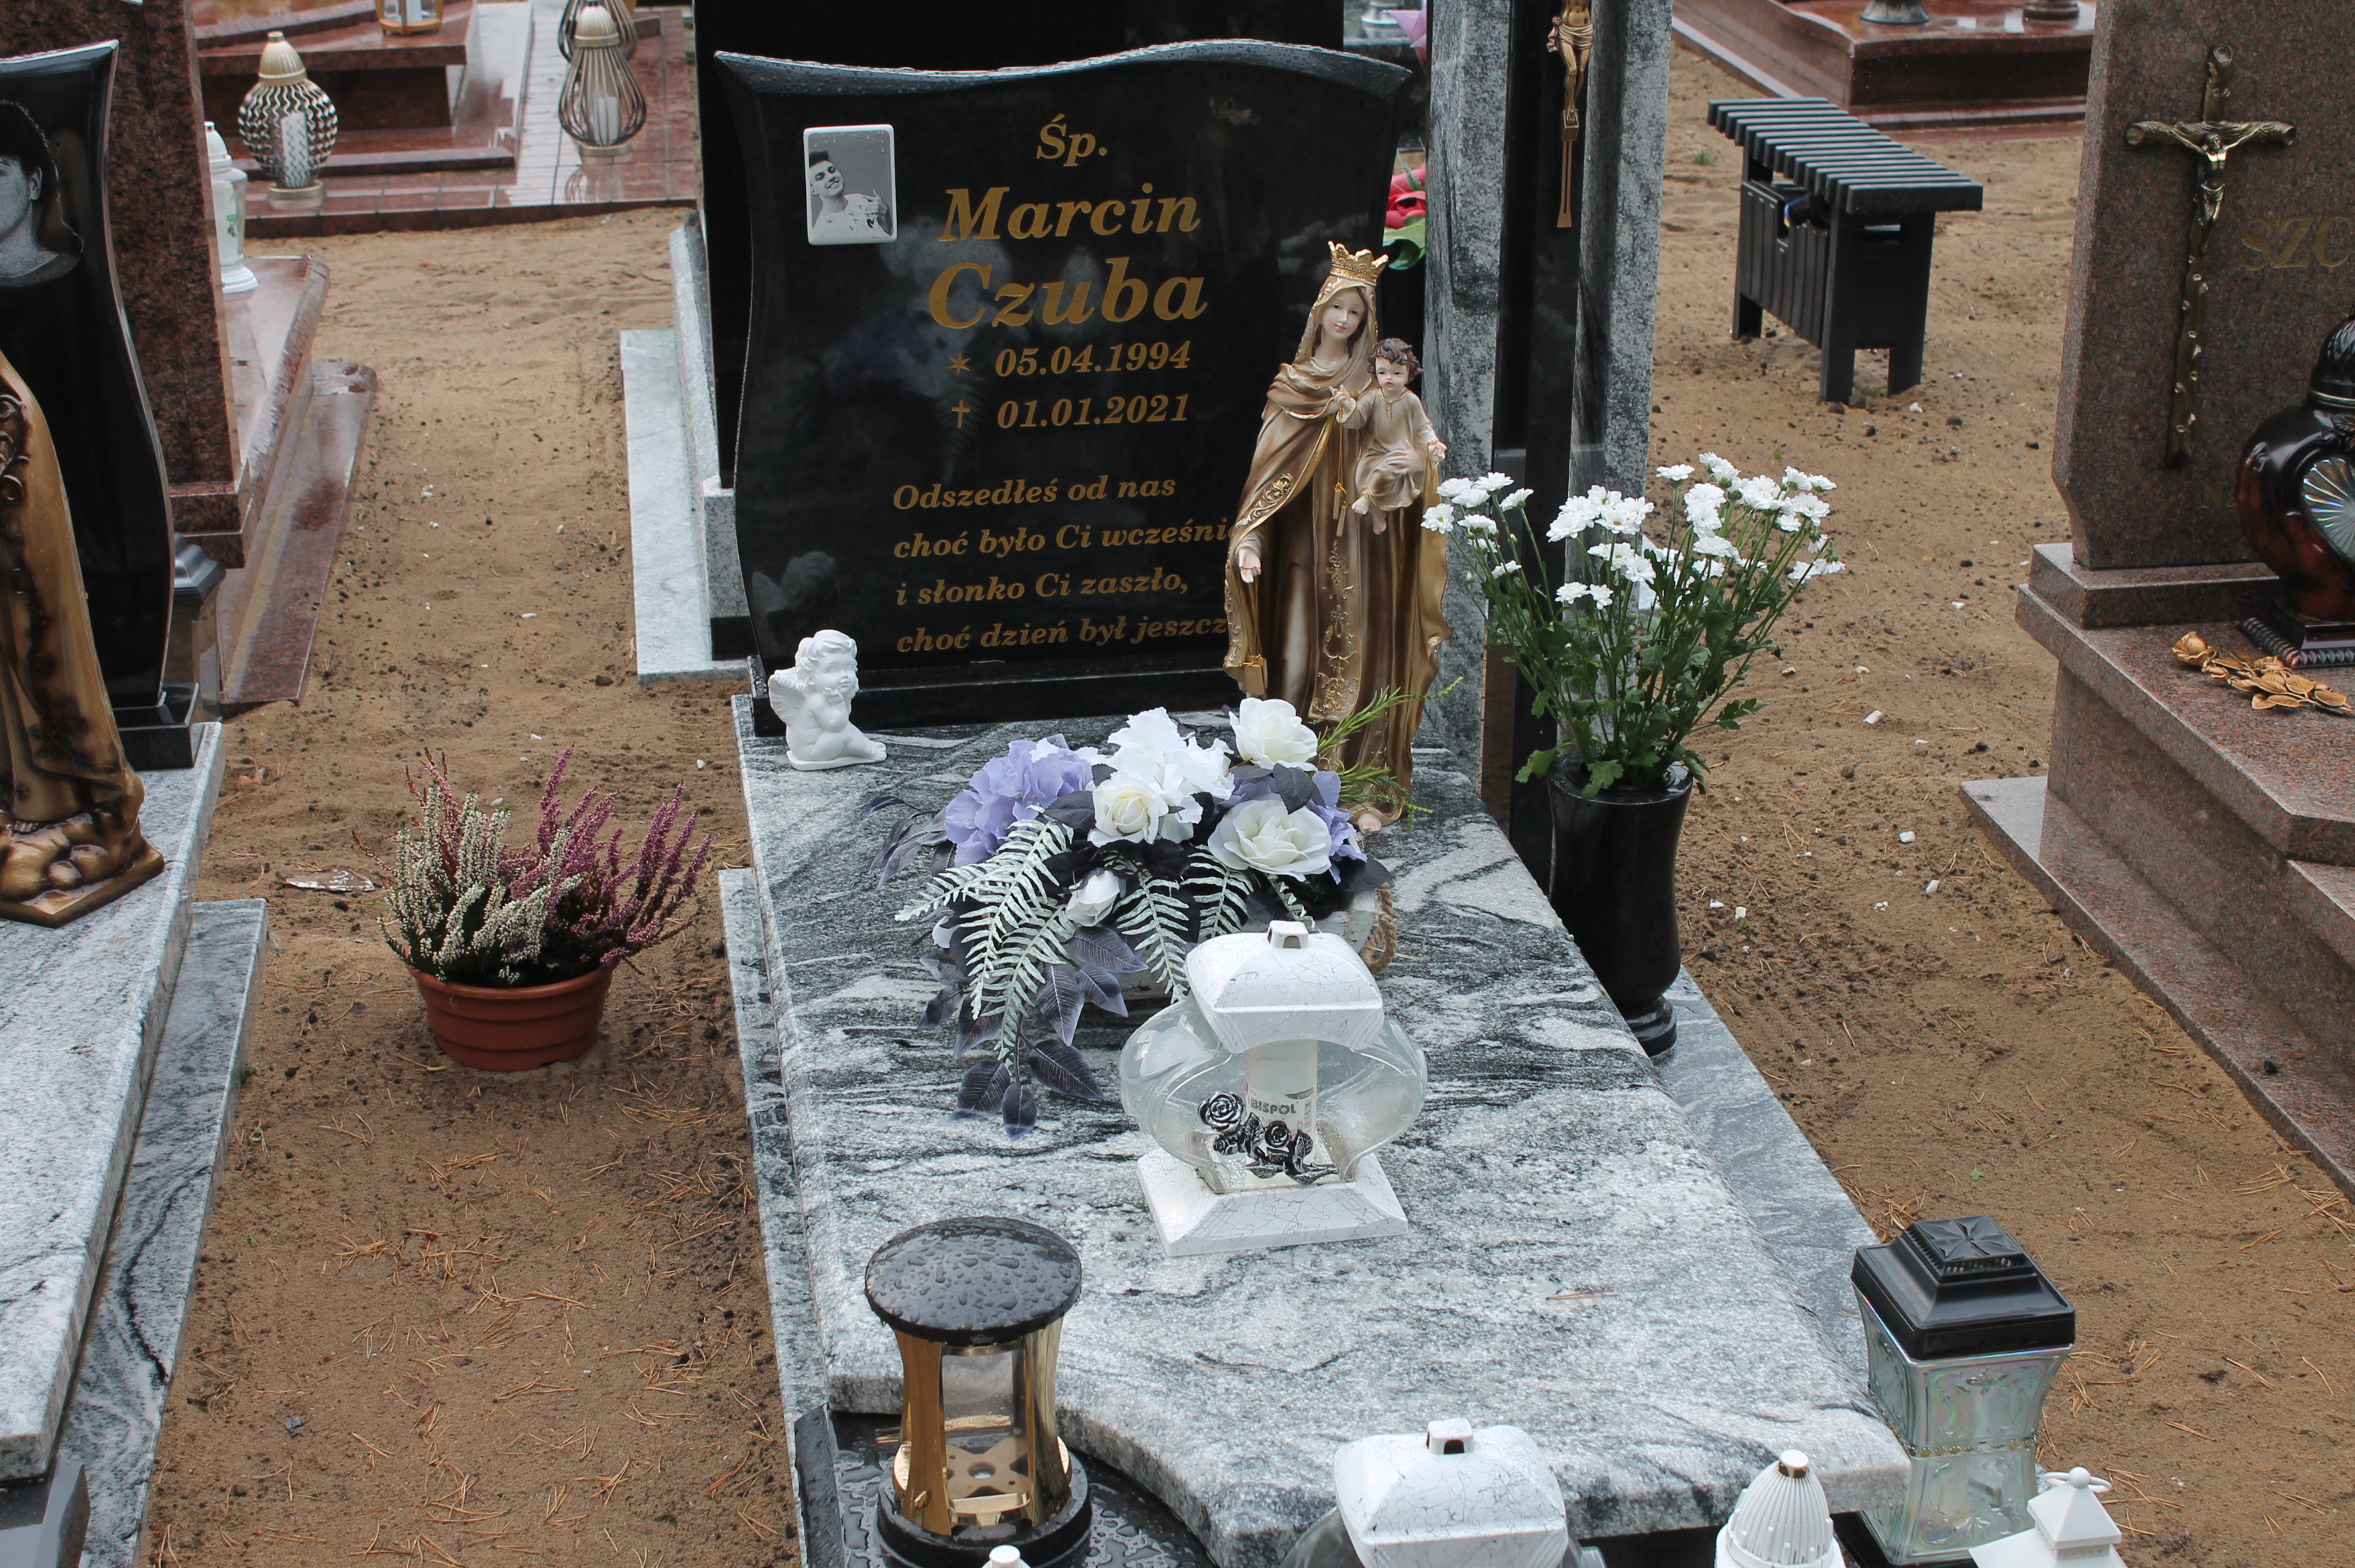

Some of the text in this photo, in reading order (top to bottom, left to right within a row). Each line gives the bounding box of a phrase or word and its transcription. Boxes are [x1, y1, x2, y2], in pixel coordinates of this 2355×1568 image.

[1036, 113, 1108, 166] Śp.
[938, 182, 1201, 241] Marcin
[929, 256, 1208, 329] Czuba
[995, 340, 1191, 376] 05.04.1994
[998, 394, 1189, 428] 01.01.2021
[894, 475, 1176, 509] Odszedłeś od nas
[894, 532, 969, 557] choć
[979, 527, 1046, 557] było
[1056, 525, 1091, 548] Ci
[898, 567, 1187, 605] i słonko Ci zaszło,
[898, 626, 970, 652] choć
[981, 621, 1067, 647] dzień
[1080, 616, 1126, 645] był
[1251, 1098, 1296, 1114] BISPOL
